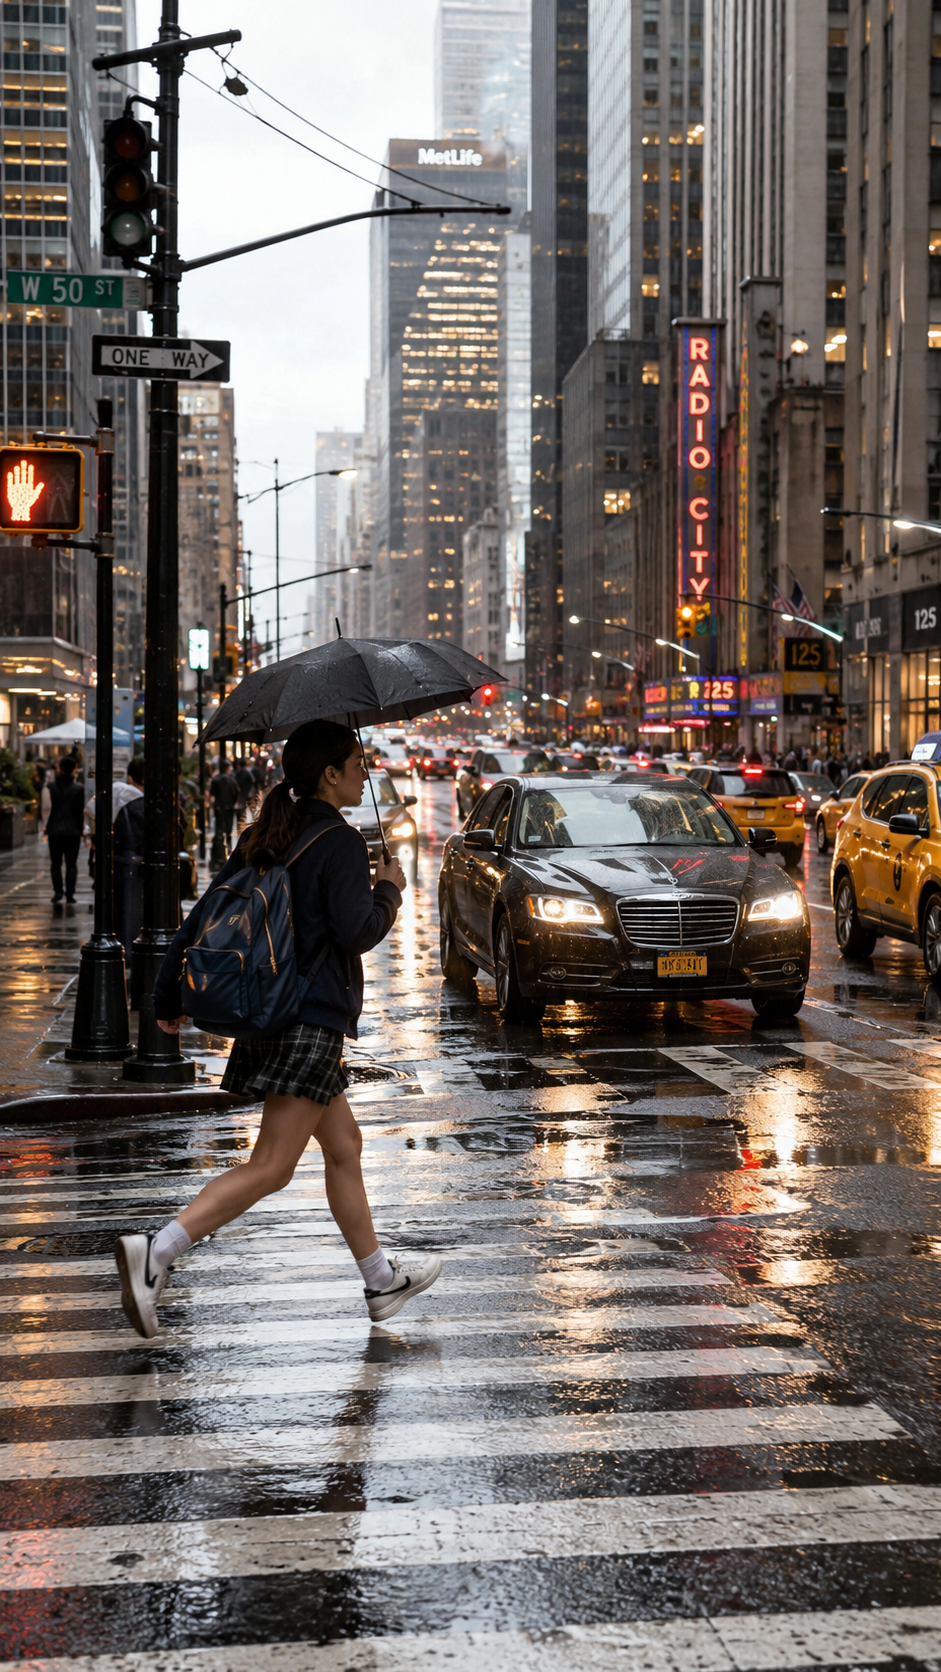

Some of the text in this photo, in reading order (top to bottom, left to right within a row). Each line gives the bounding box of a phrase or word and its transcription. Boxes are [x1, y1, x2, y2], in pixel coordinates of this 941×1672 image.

[418, 148, 483, 166] MetLife
[21, 276, 40, 301] W
[52, 277, 83, 303] 50
[95, 279, 115, 295] ST
[112, 348, 209, 369] ONE WAY
[688, 337, 711, 601] RADIO CITY
[914, 606, 937, 631] 125
[791, 643, 821, 666] 125
